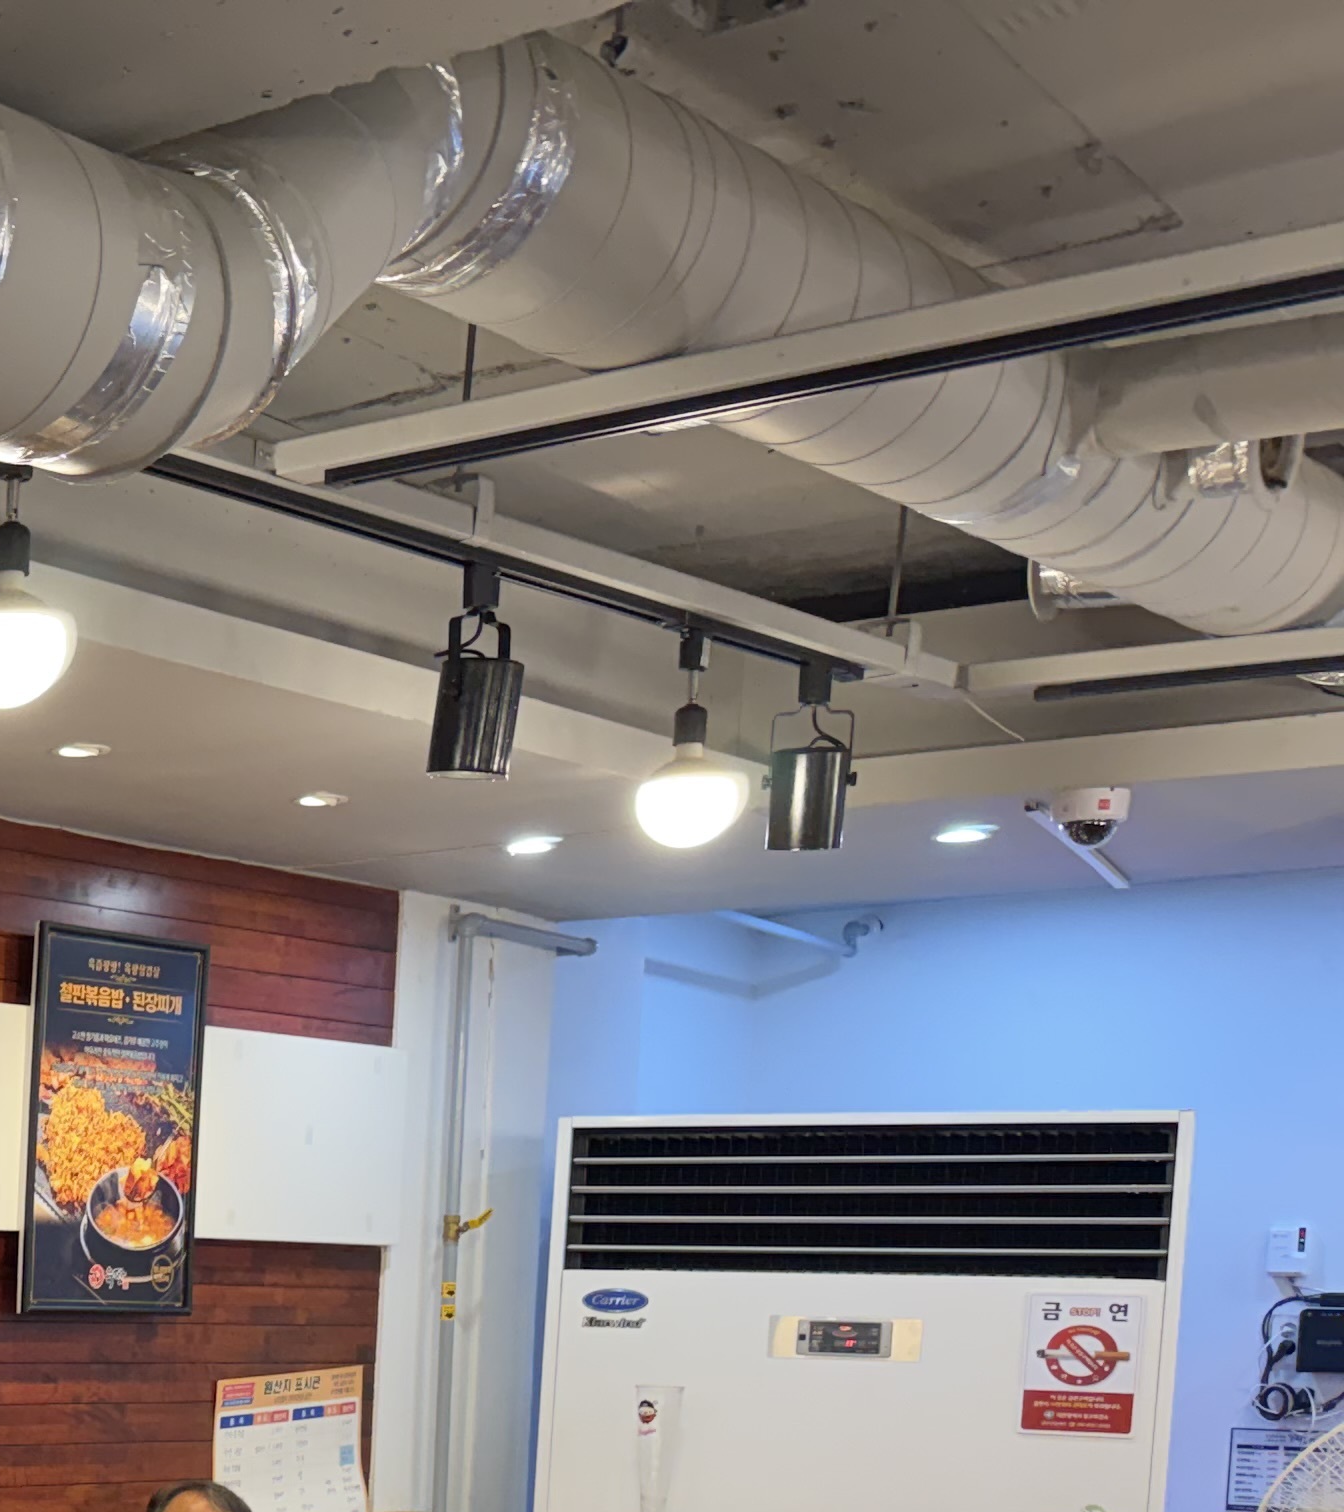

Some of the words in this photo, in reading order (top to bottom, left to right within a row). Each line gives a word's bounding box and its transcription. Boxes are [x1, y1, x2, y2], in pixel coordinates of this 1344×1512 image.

[60, 982, 124, 1009] 철판볶음밥
[132, 990, 183, 1016] 된장찌개
[1042, 1302, 1062, 1321] 금
[1109, 1303, 1129, 1322] 연
